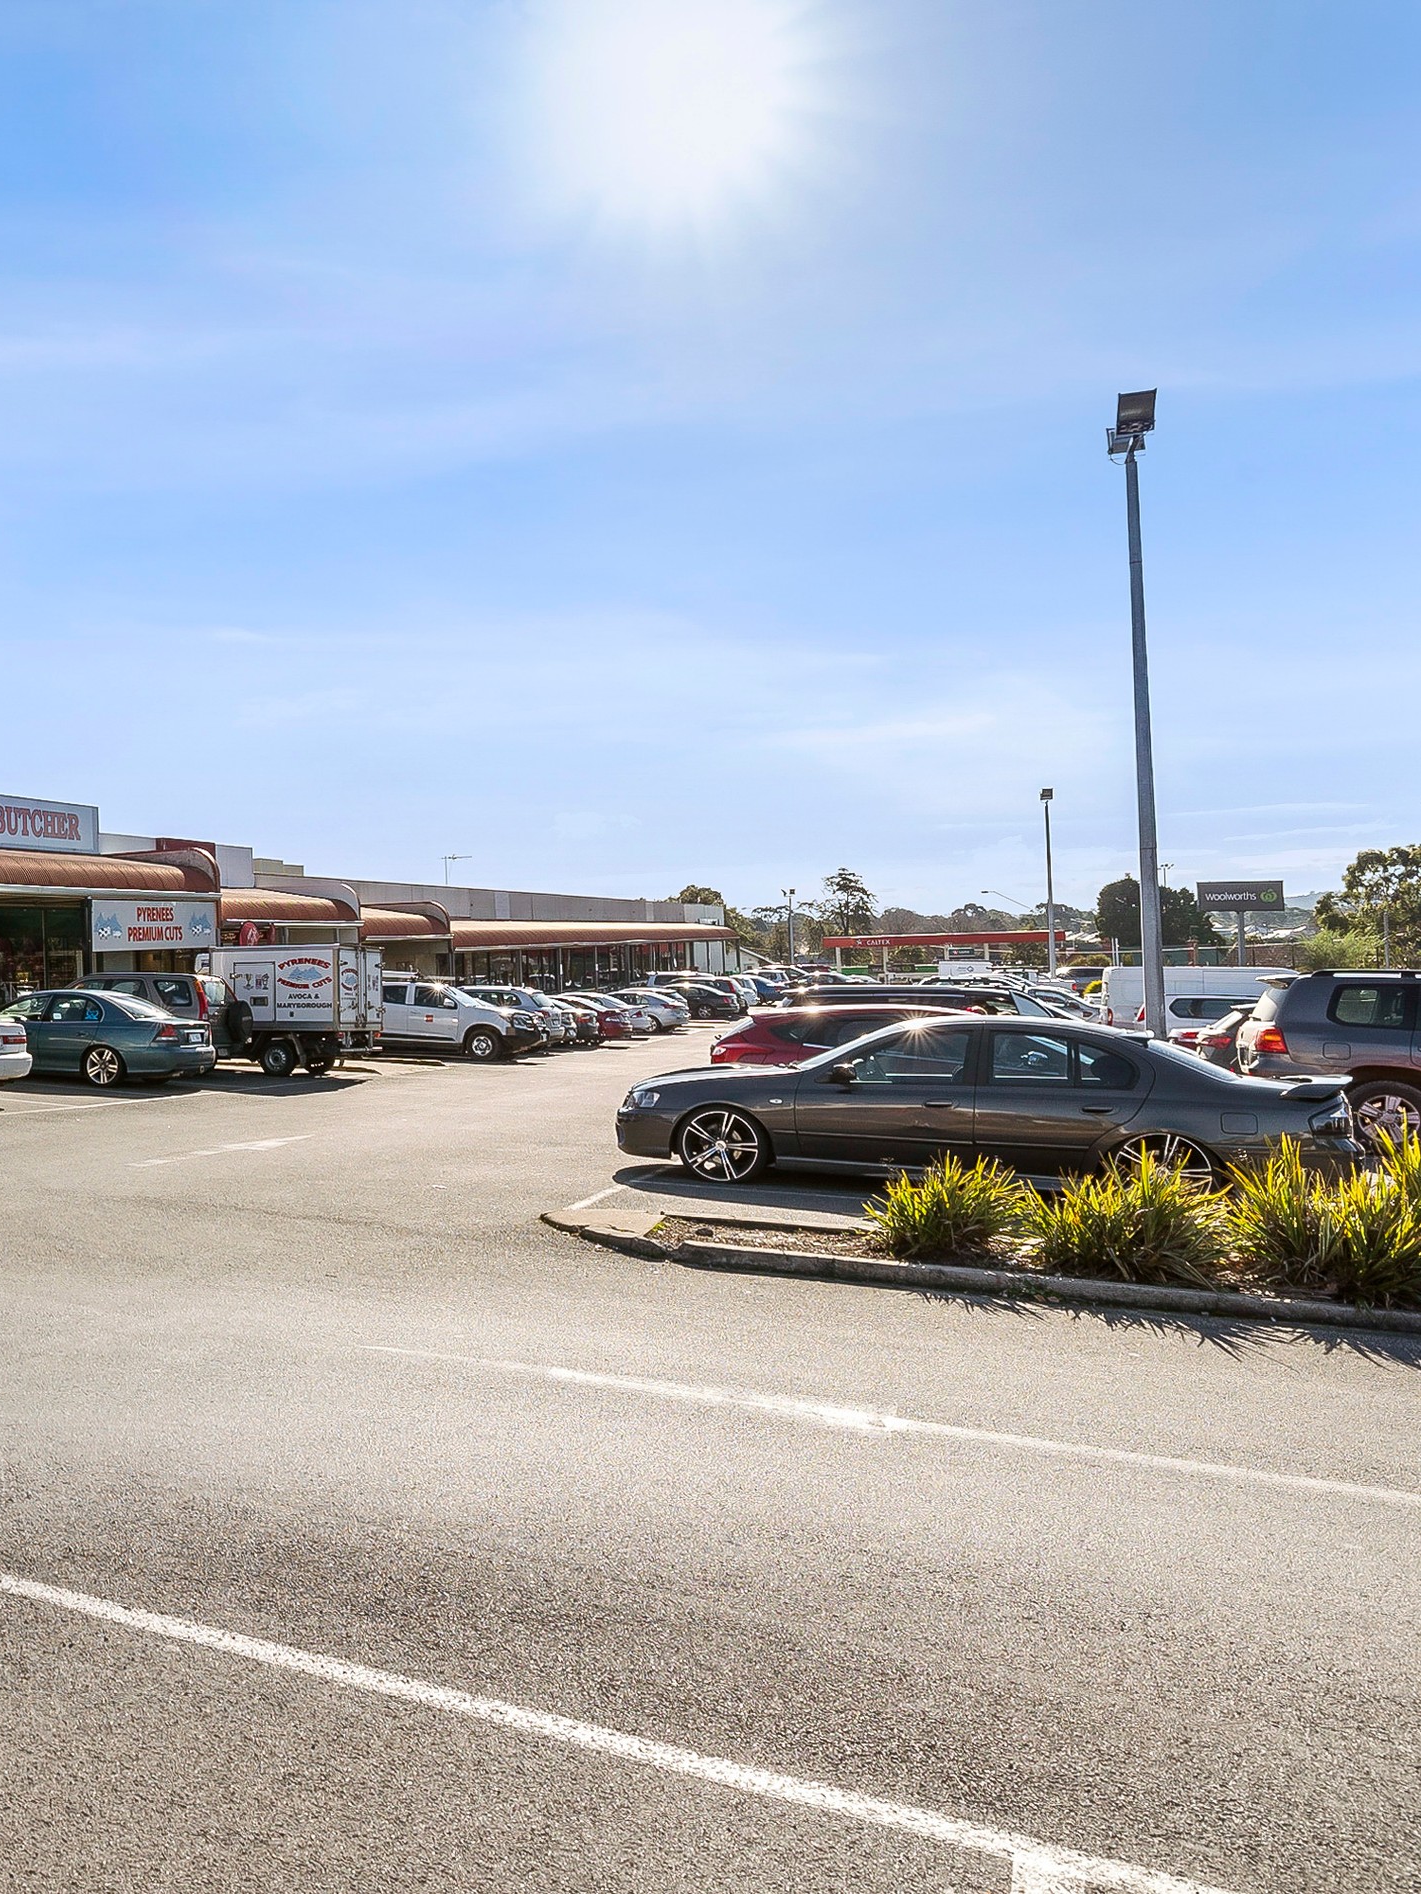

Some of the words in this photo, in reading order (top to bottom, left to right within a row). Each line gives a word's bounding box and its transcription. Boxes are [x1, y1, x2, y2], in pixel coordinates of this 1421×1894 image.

[1204, 890, 1257, 902] woolworths
[136, 907, 174, 922] PYRENEES
[127, 926, 164, 942] PREMIUM
[164, 926, 183, 942] CUTS
[277, 958, 331, 970] PYRENEES
[311, 976, 333, 989] CUTS
